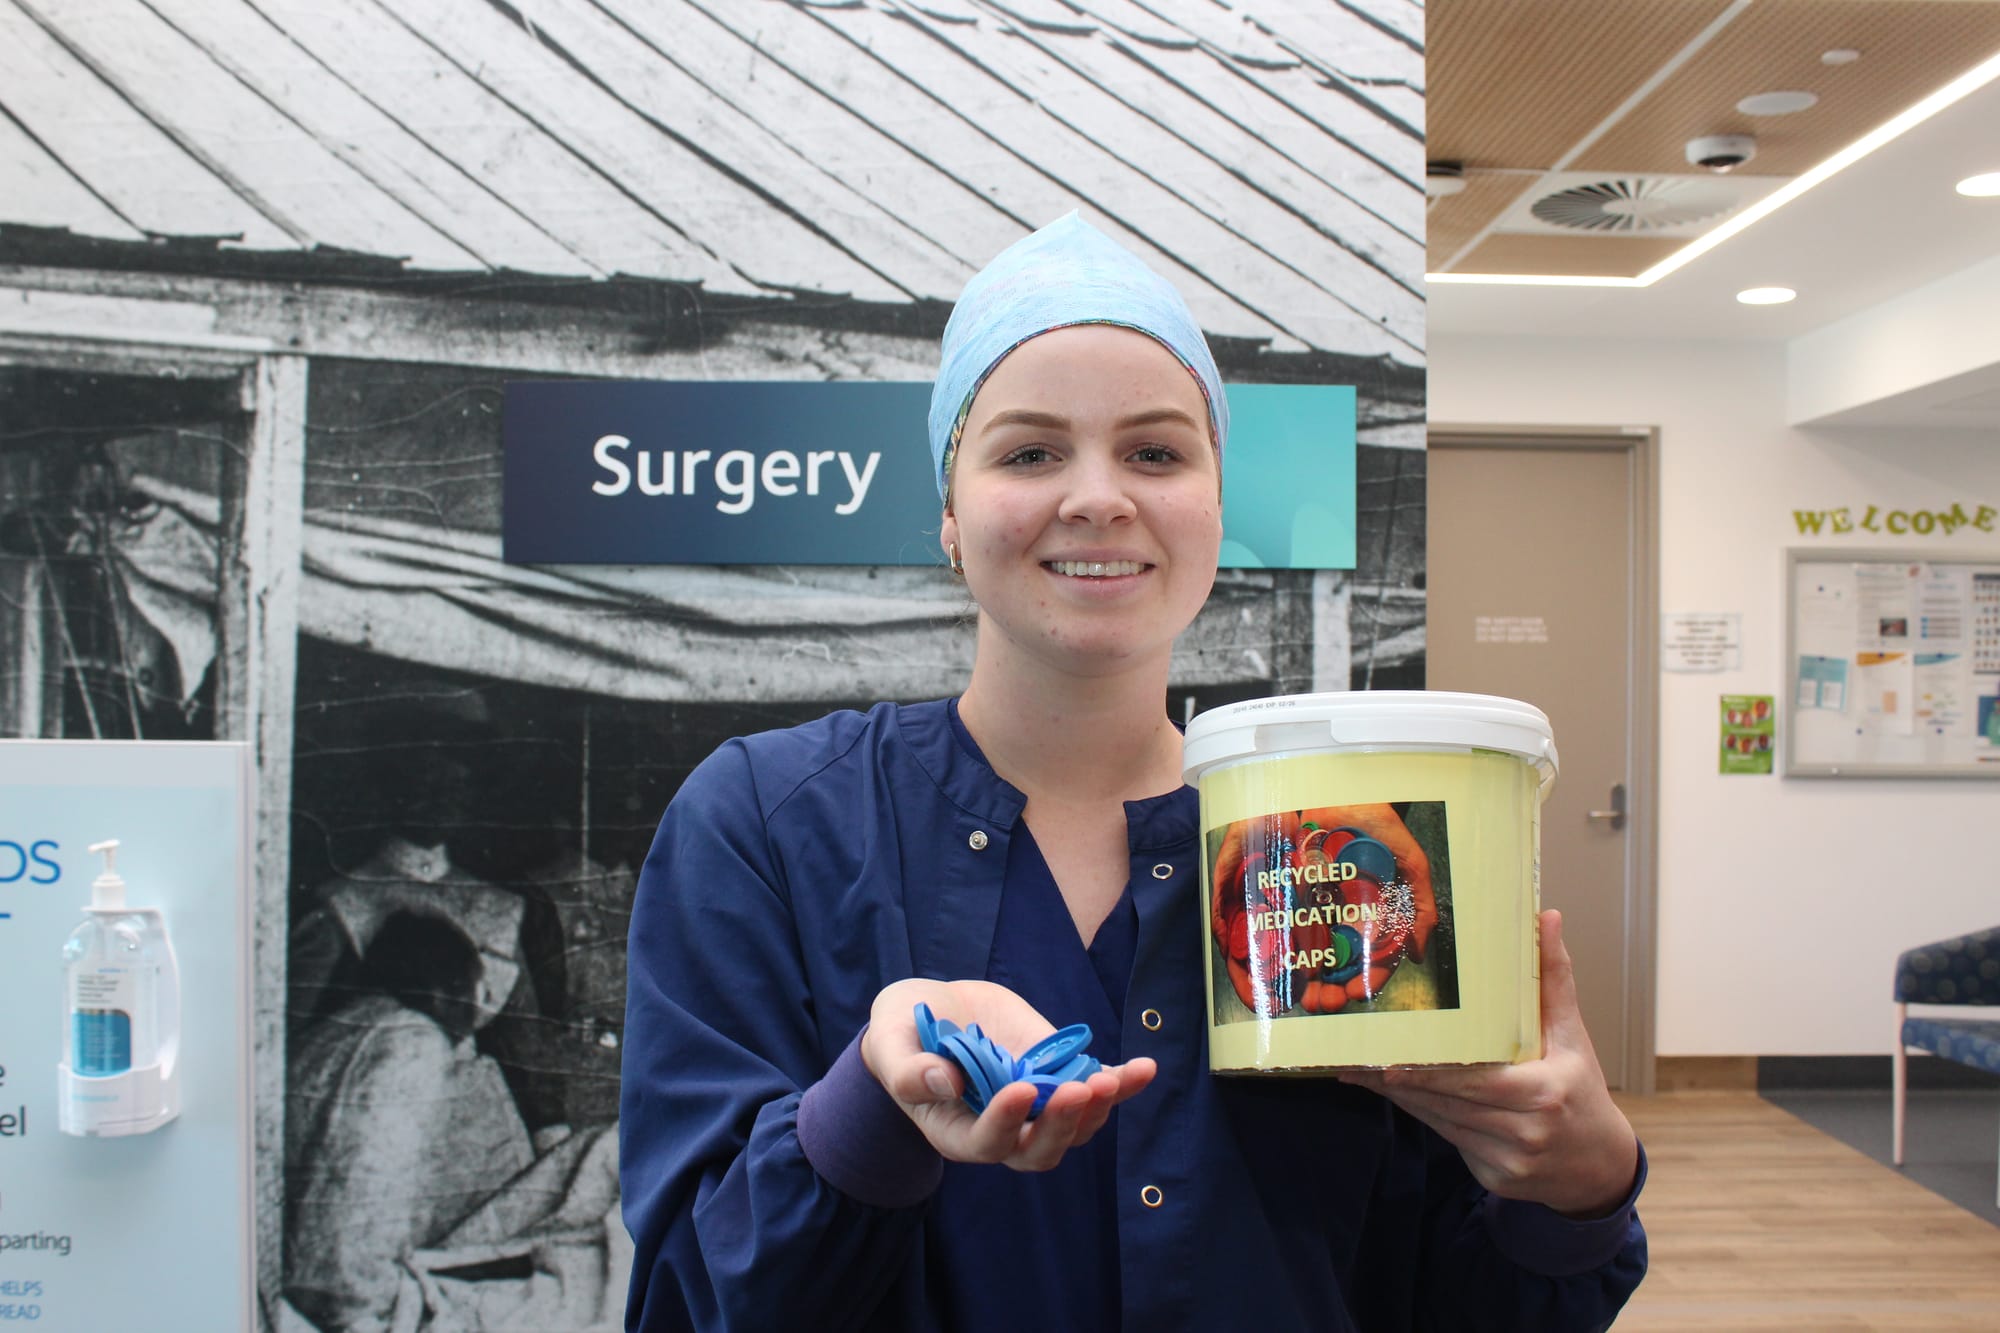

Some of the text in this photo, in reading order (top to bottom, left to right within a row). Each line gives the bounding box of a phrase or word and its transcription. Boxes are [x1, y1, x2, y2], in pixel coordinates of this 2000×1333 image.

[592, 434, 881, 515] Surgery
[1792, 503, 1997, 536] WELCOME
[1257, 862, 1358, 890] RECYCLED
[1250, 902, 1378, 932] MEDICATION
[1284, 947, 1337, 970] CAPS
